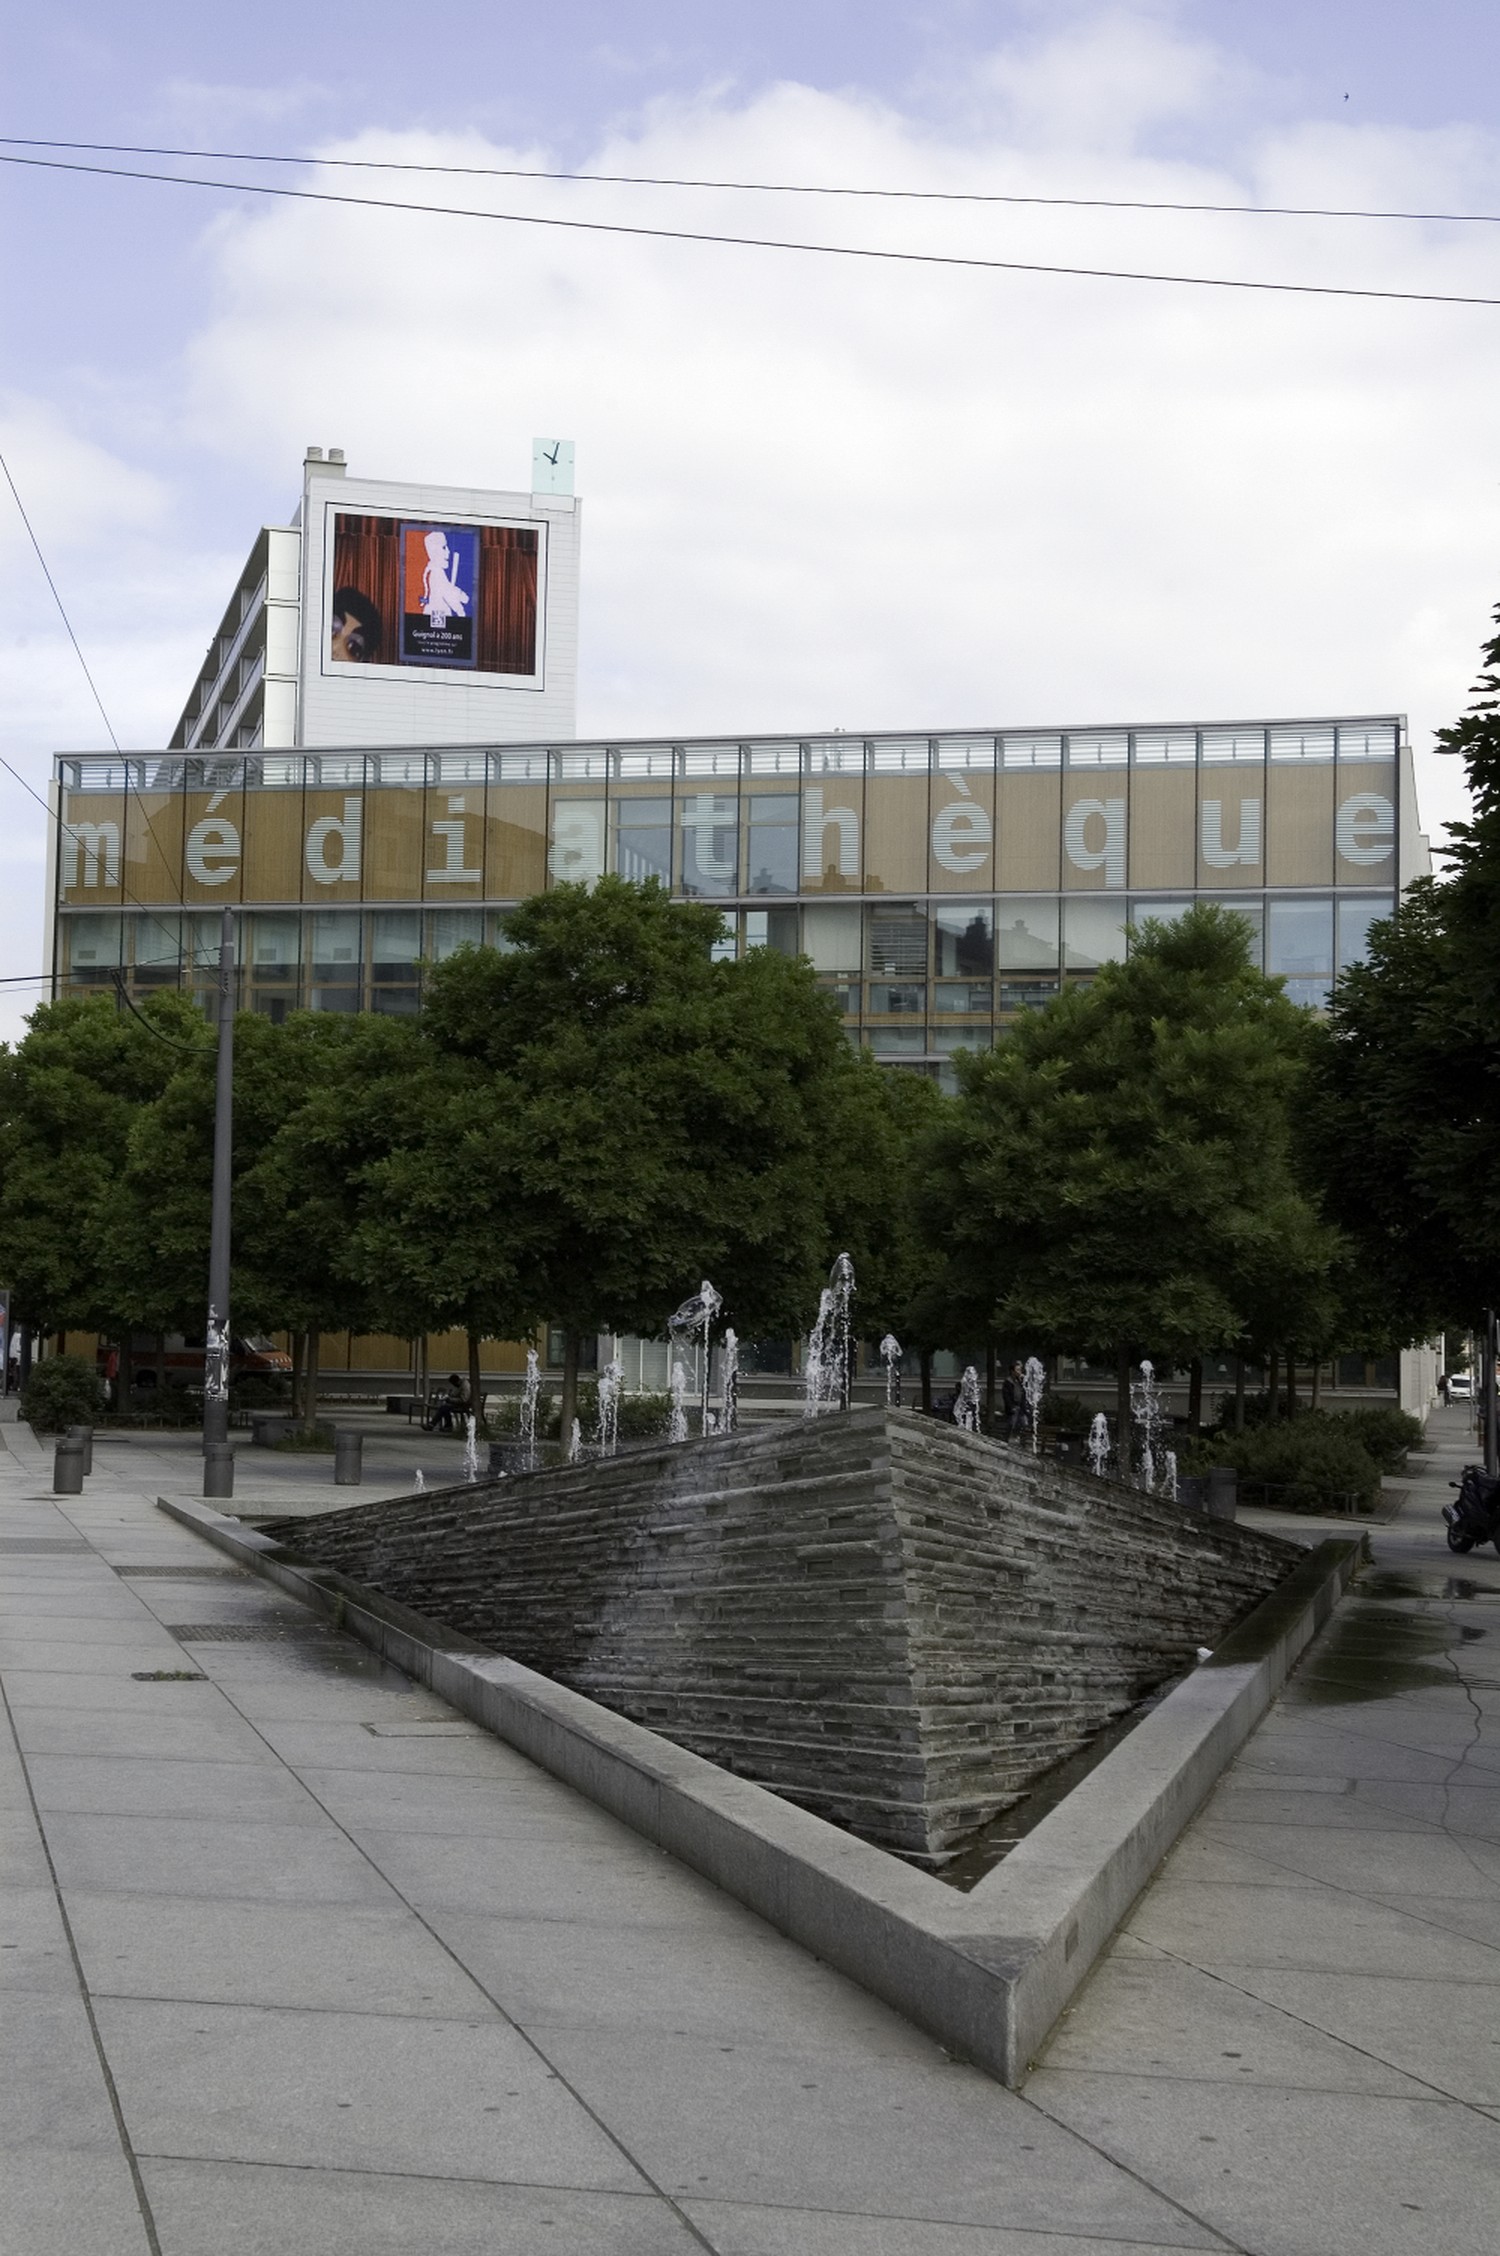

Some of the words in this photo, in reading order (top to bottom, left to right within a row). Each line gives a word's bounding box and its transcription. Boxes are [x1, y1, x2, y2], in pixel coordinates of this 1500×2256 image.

[412, 629, 435, 639] Guignol
[440, 631, 452, 640] 200
[62, 772, 1394, 888] médiathèque
